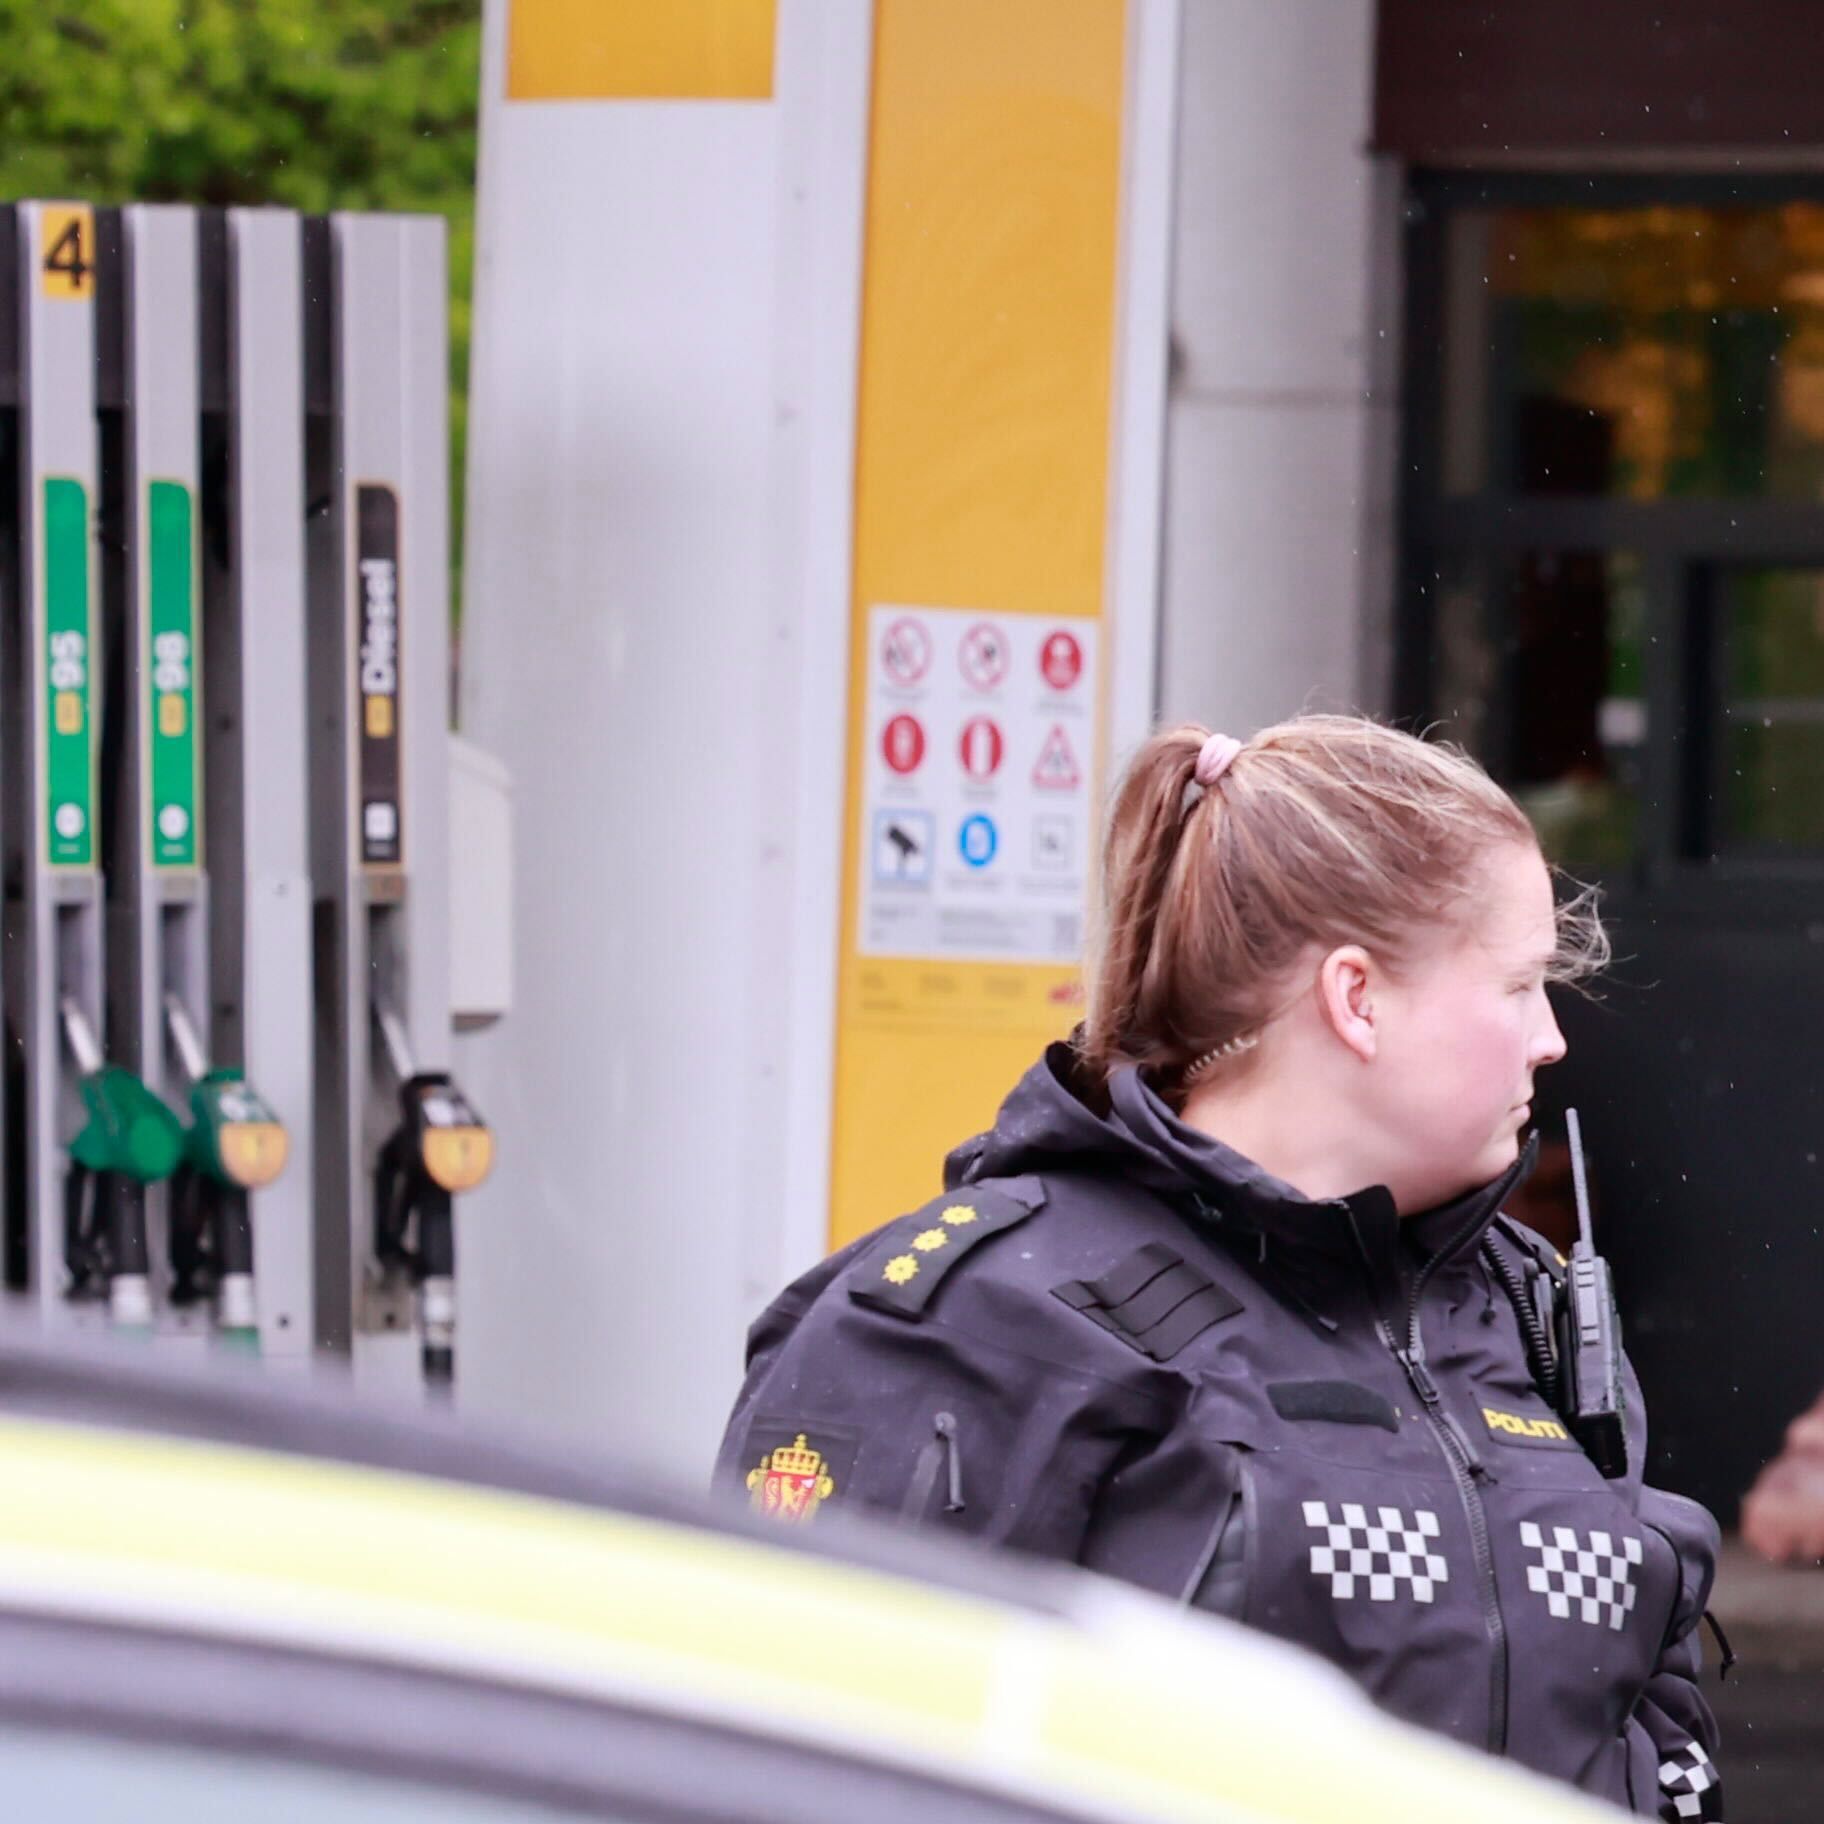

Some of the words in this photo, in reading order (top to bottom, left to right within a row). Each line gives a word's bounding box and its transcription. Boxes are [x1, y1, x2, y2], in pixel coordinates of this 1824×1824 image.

[43, 219, 94, 290] 4
[360, 557, 396, 694] Diesel
[50, 630, 85, 689] 95
[153, 630, 189, 692] 98
[1482, 1408, 1568, 1440] POLITI
